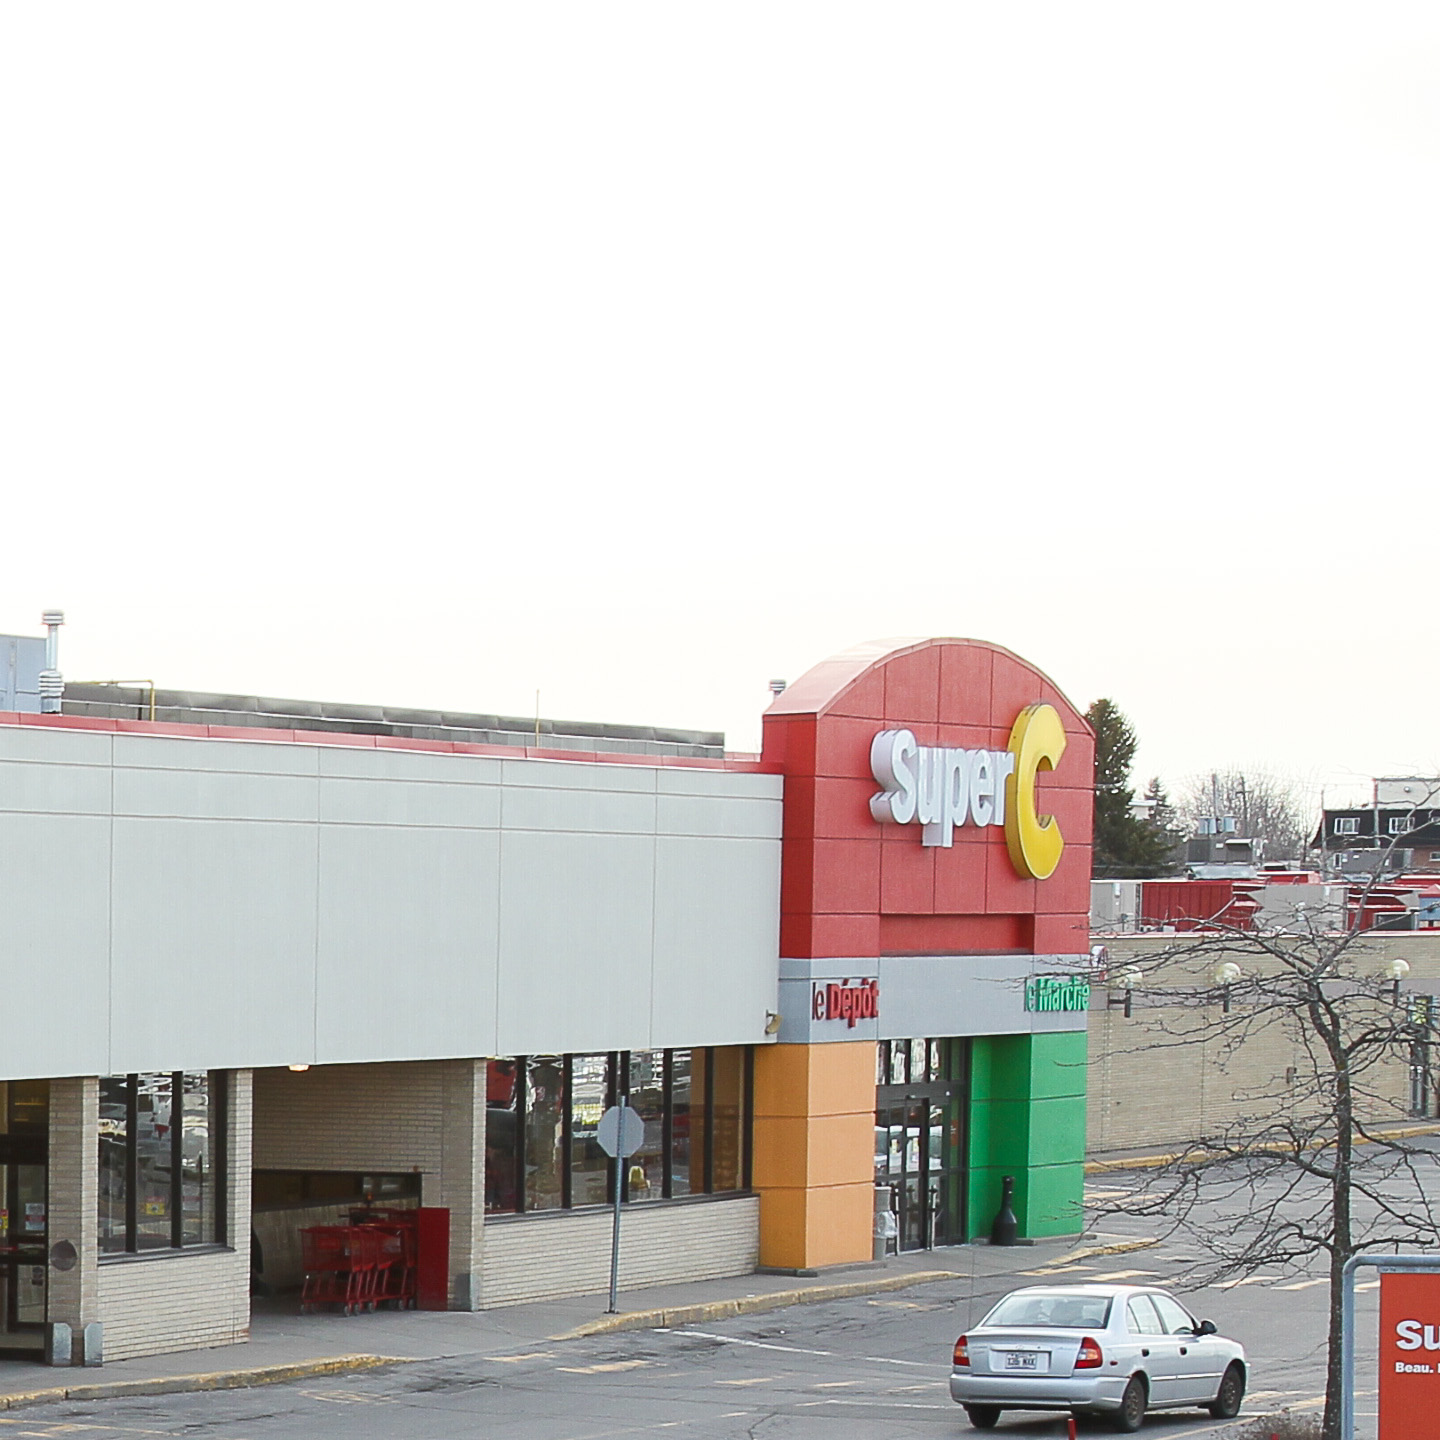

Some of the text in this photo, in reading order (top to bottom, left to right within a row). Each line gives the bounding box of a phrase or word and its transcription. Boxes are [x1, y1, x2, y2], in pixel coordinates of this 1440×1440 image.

[869, 703, 1067, 880] Super C
[812, 982, 825, 1021] le
[1395, 1361, 1434, 1374] Beau.
